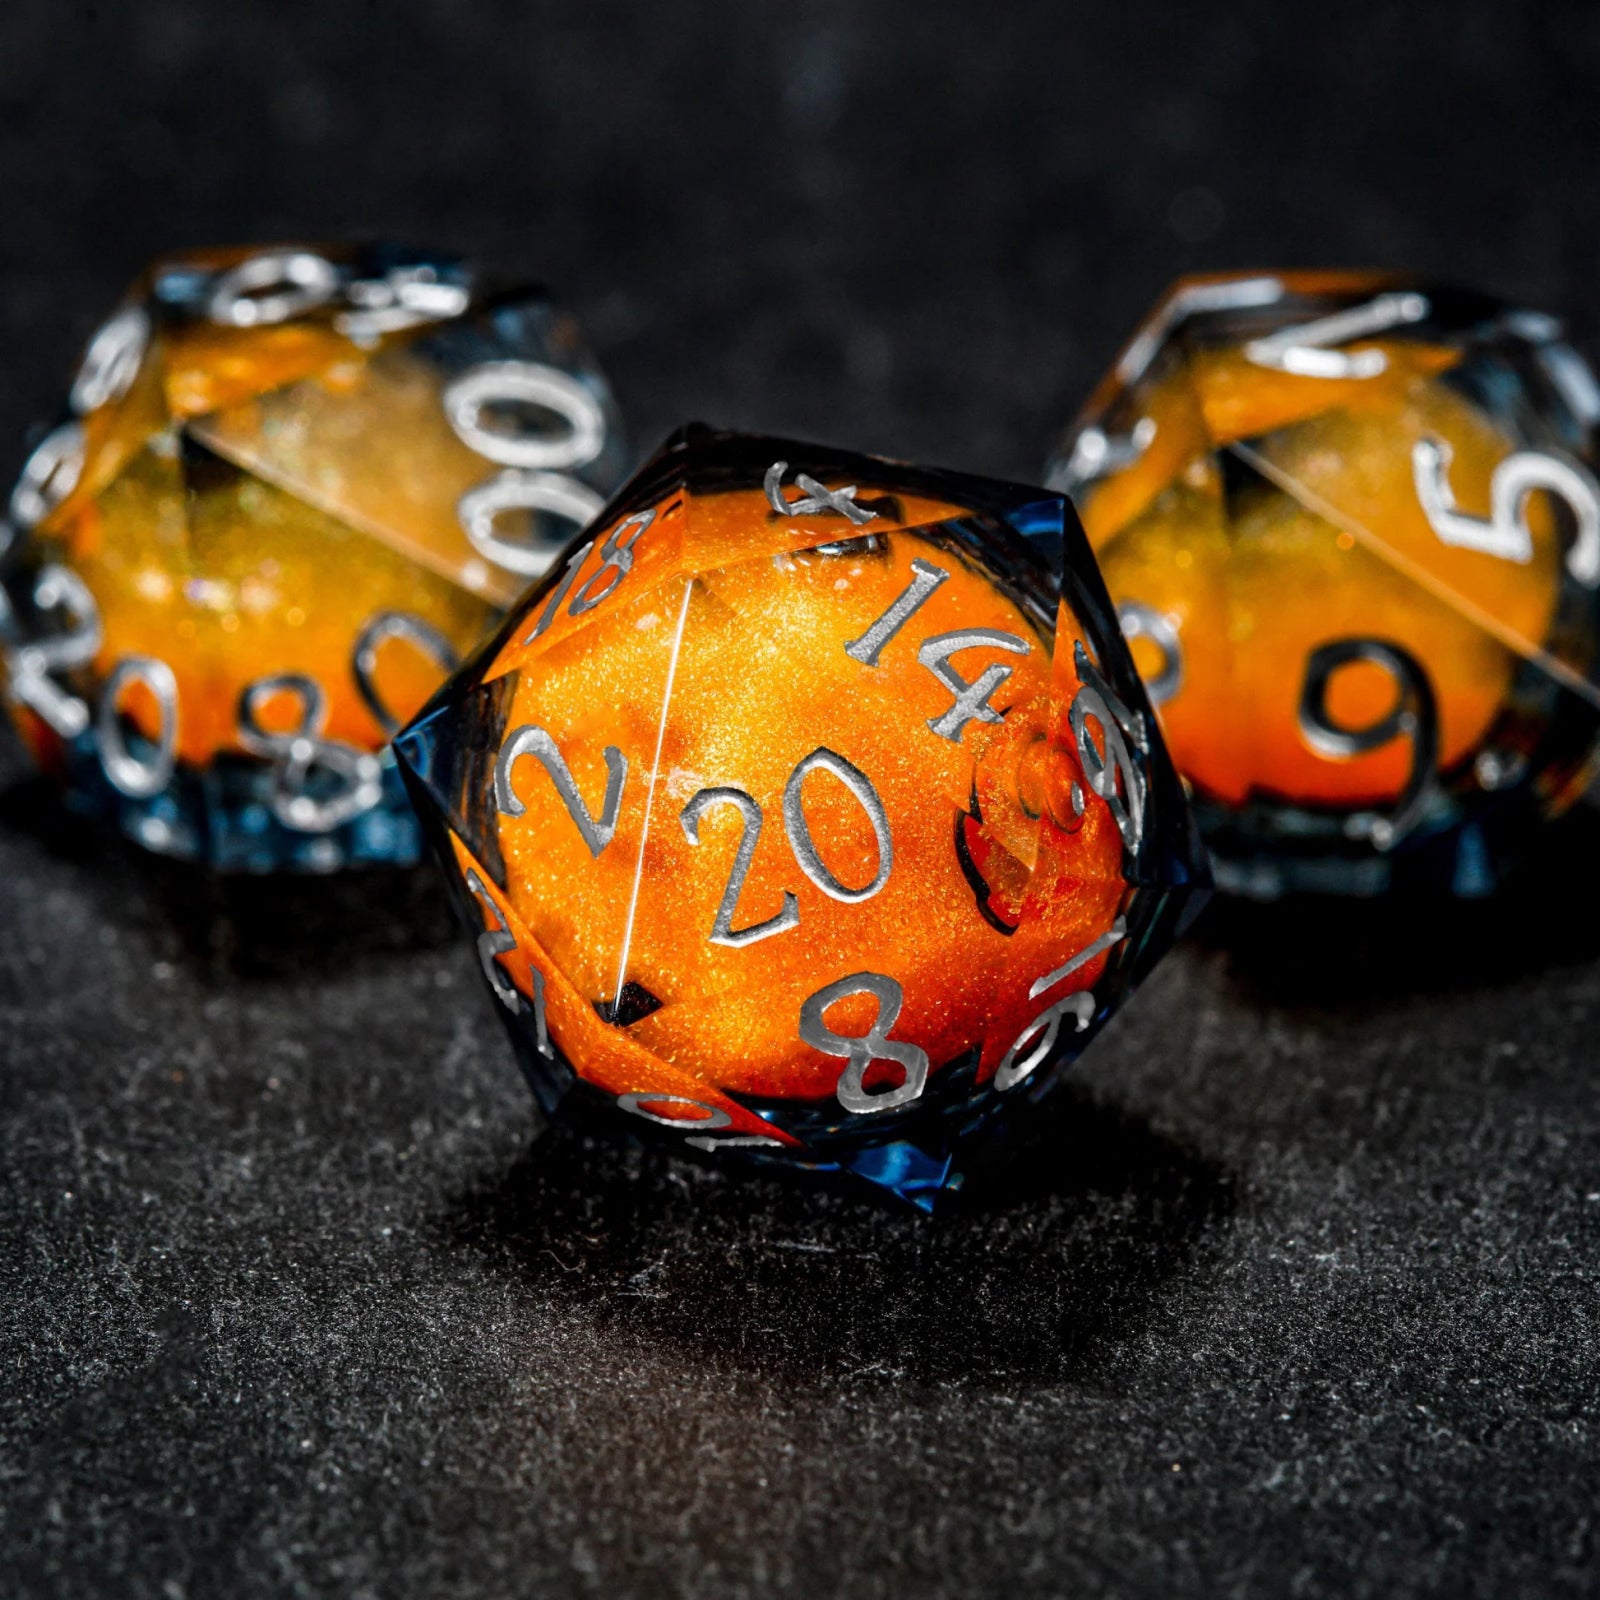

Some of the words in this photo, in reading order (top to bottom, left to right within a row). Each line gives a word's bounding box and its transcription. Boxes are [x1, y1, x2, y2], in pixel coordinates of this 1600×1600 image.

[764, 461, 879, 525] 4
[1412, 436, 1600, 590] 5
[524, 509, 657, 646] 18
[844, 557, 1031, 743] 14
[494, 724, 629, 859] 2
[1296, 634, 1442, 852] 9
[680, 746, 893, 948] 20
[798, 971, 929, 1114] 8
[994, 915, 1127, 1092] 16
